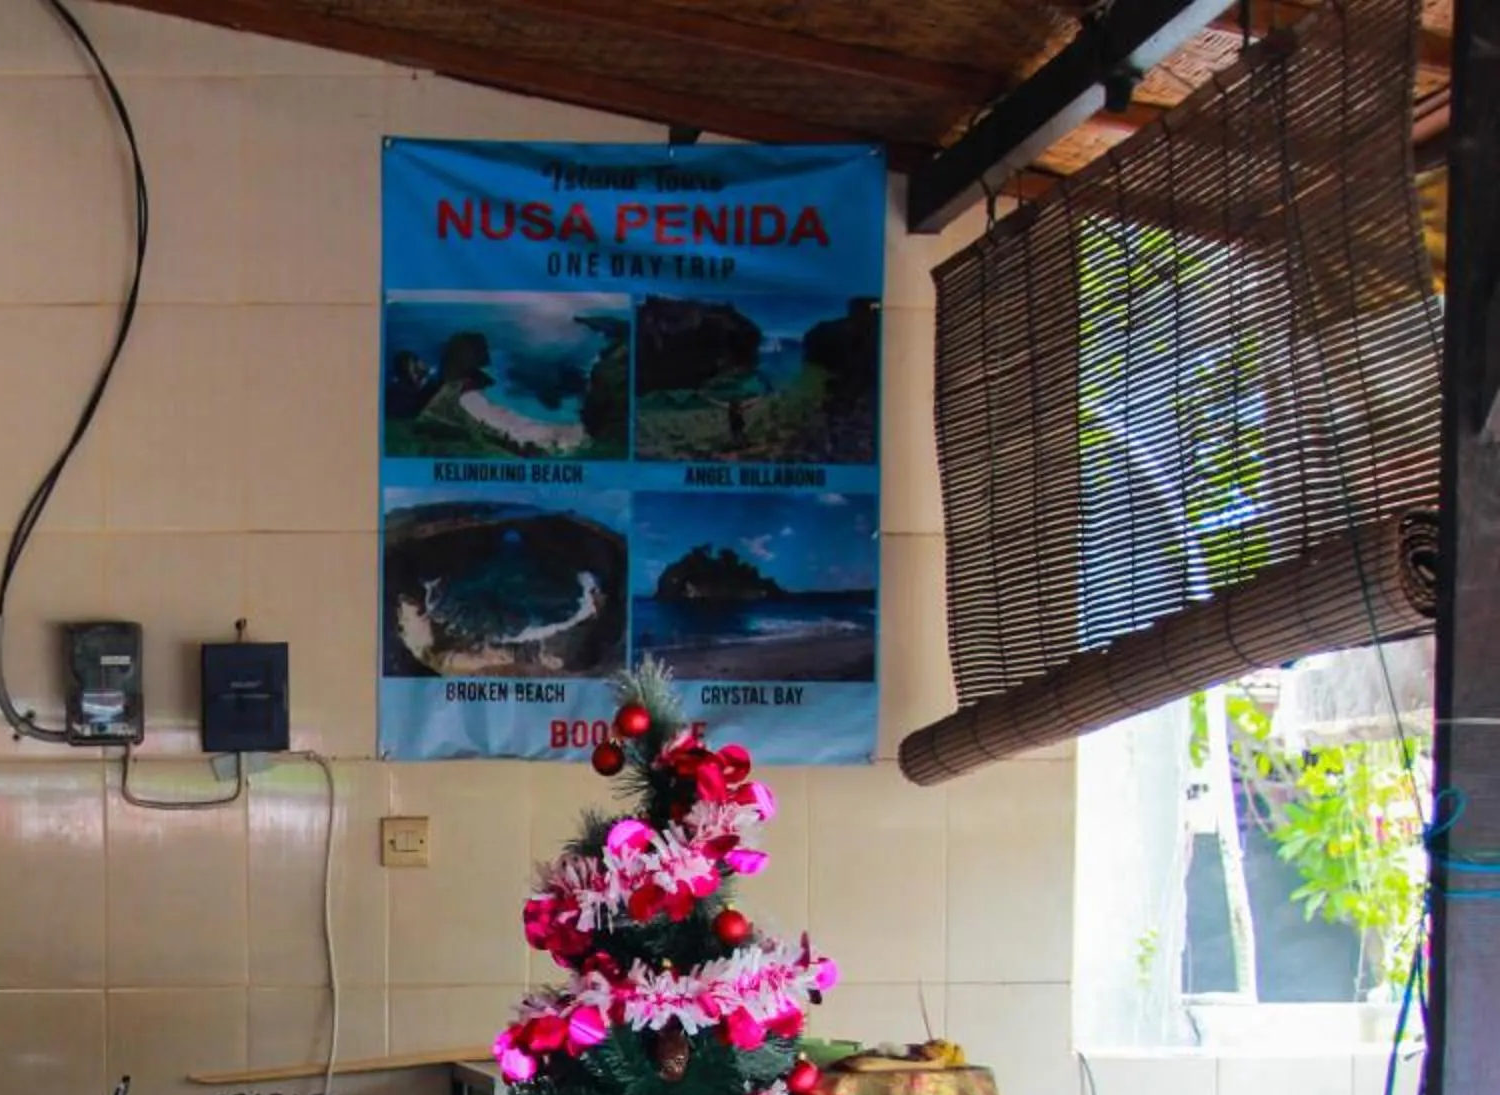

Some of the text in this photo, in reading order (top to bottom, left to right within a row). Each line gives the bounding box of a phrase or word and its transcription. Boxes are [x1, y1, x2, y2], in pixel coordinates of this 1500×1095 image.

[436, 198, 831, 248] NUSA PENIDA
[548, 252, 736, 279] ONE DAY TRIP
[531, 464, 584, 484] BEACH
[445, 682, 566, 704] BROKEN BEACH
[701, 685, 805, 707] CRYSTAL BAY
[550, 719, 616, 748] BOO
